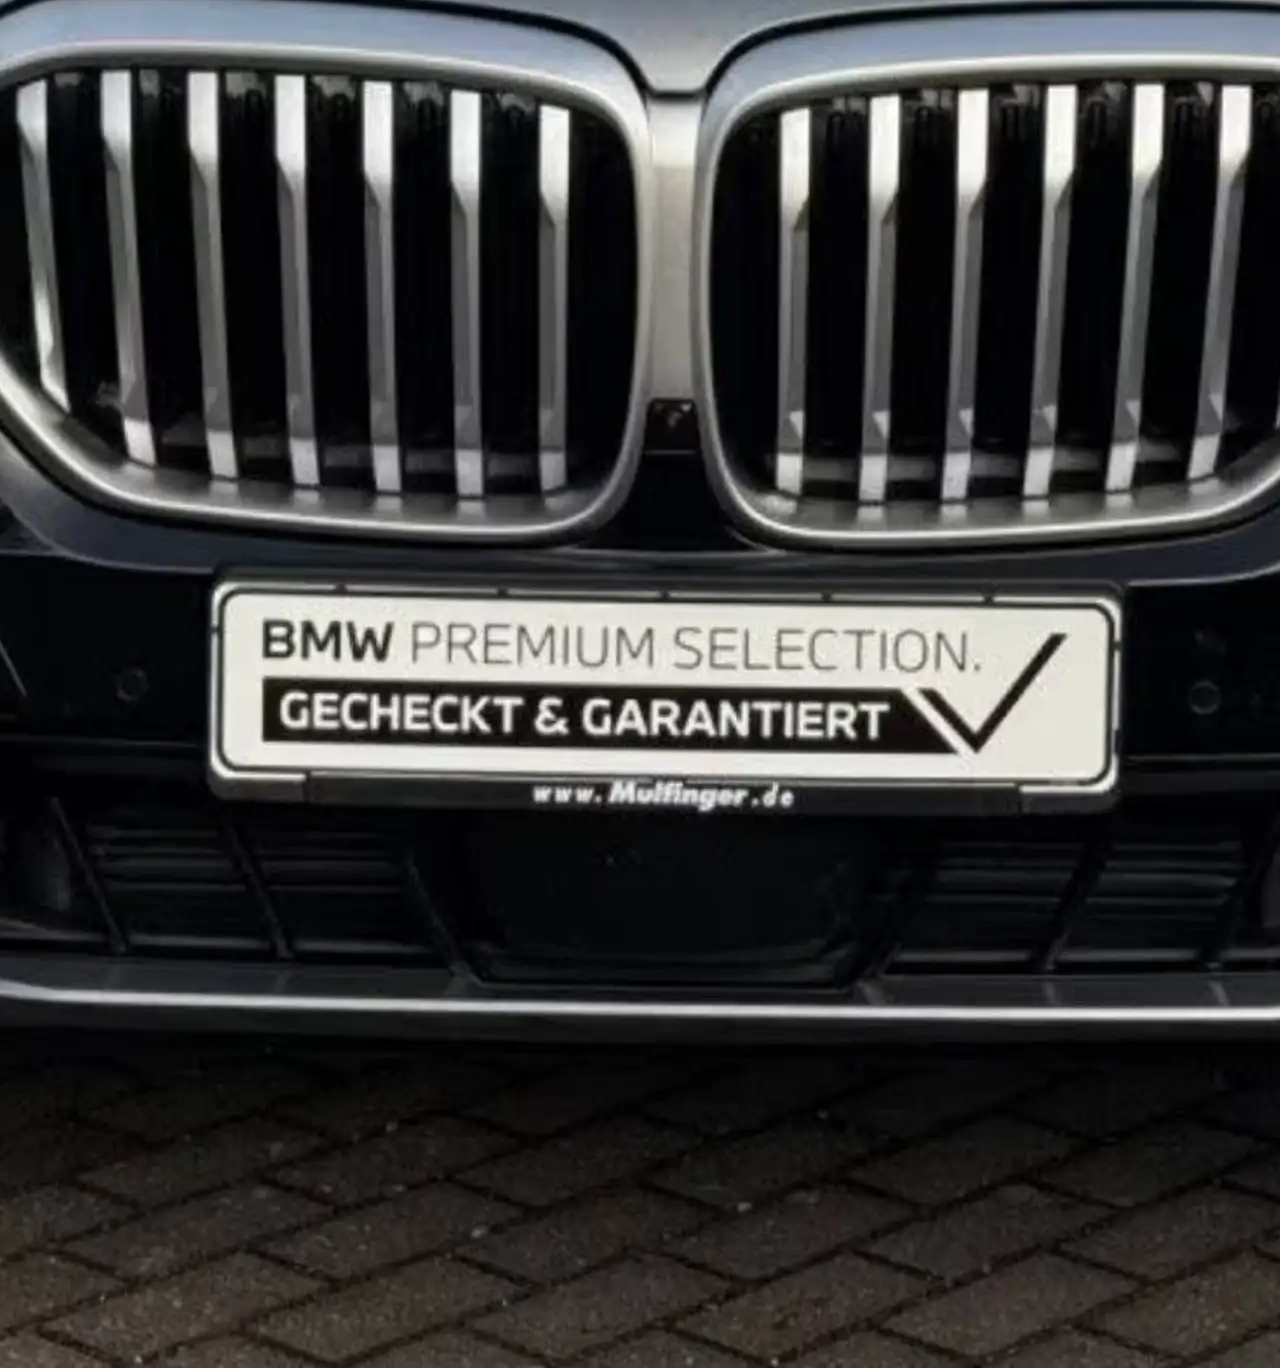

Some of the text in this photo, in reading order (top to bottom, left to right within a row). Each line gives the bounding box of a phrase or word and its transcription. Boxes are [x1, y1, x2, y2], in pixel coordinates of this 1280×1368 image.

[262, 619, 982, 673] BMW PREMIUM SELECTION.
[279, 691, 891, 740] GECHECKT & GARANTIERT
